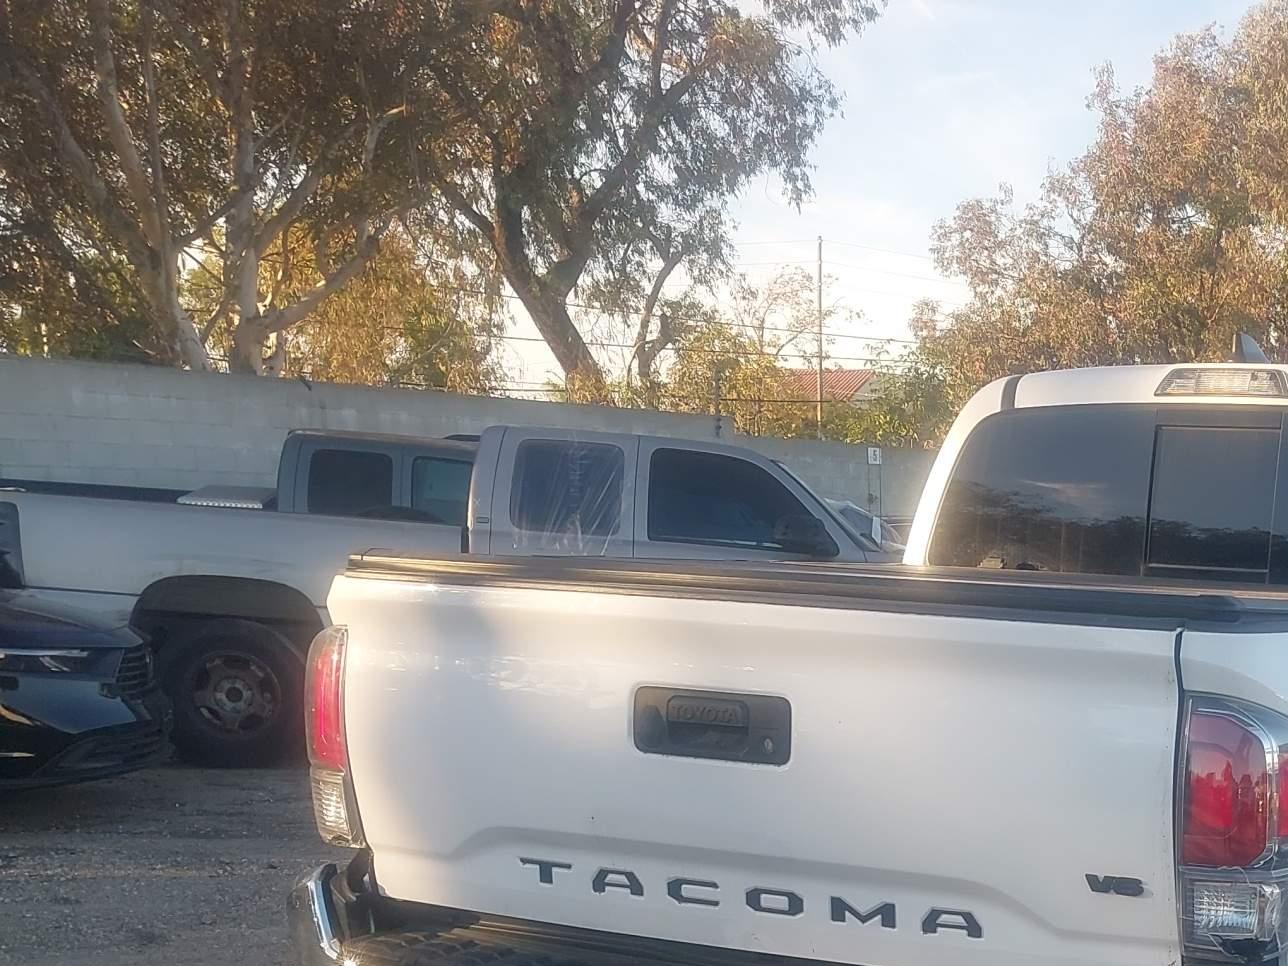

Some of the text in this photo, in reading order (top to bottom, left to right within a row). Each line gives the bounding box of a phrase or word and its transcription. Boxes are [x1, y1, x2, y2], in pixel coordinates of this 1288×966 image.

[671, 703, 738, 723] TOYOTA
[1085, 873, 1145, 897] V6
[518, 856, 983, 939] TACOMA
